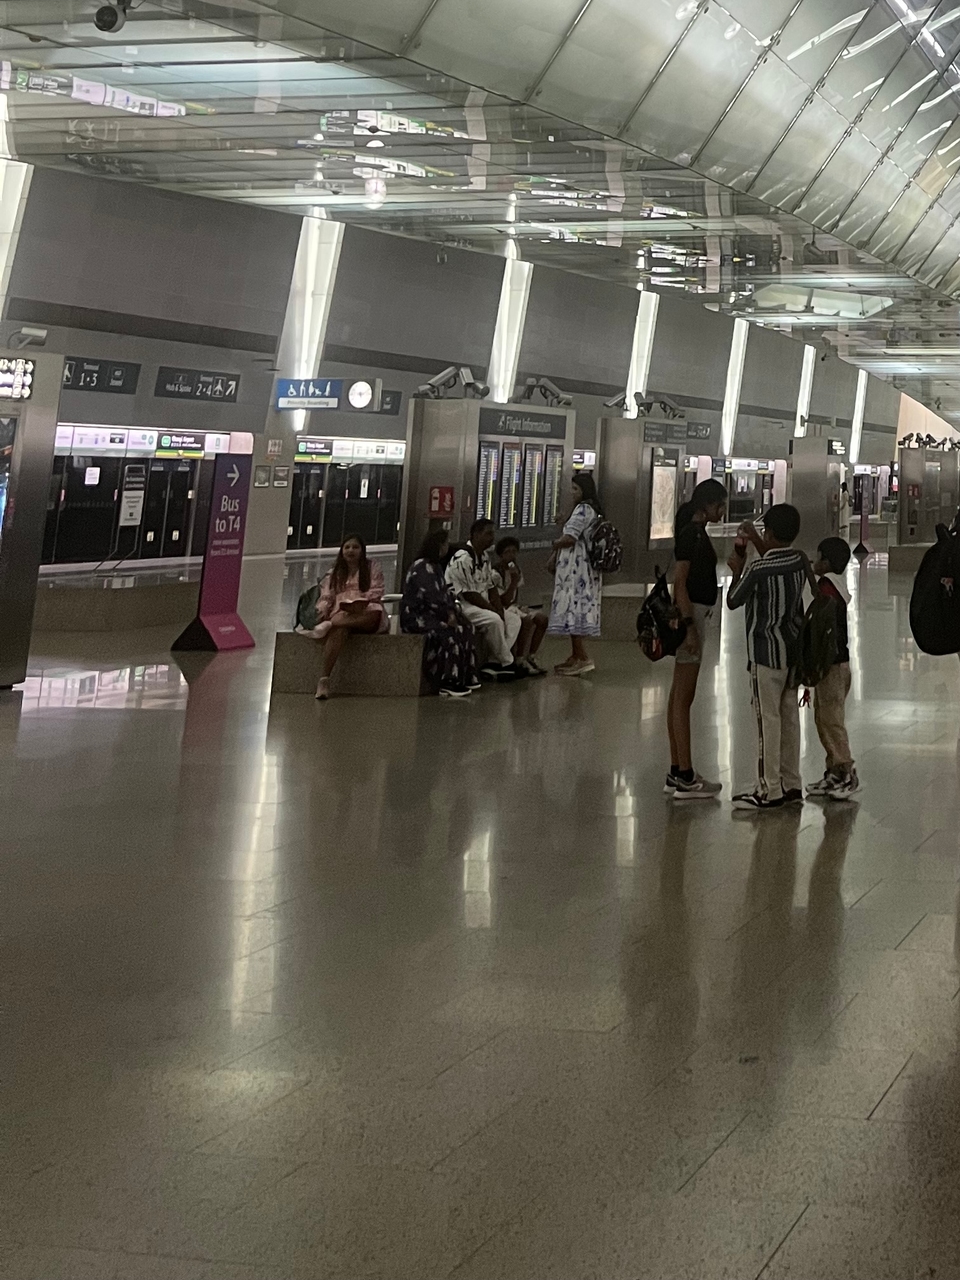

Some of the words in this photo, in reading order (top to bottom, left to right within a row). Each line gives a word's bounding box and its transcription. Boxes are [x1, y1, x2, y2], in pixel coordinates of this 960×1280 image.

[221, 495, 240, 512] Bus
[215, 517, 227, 533] to
[228, 515, 241, 532] T4
